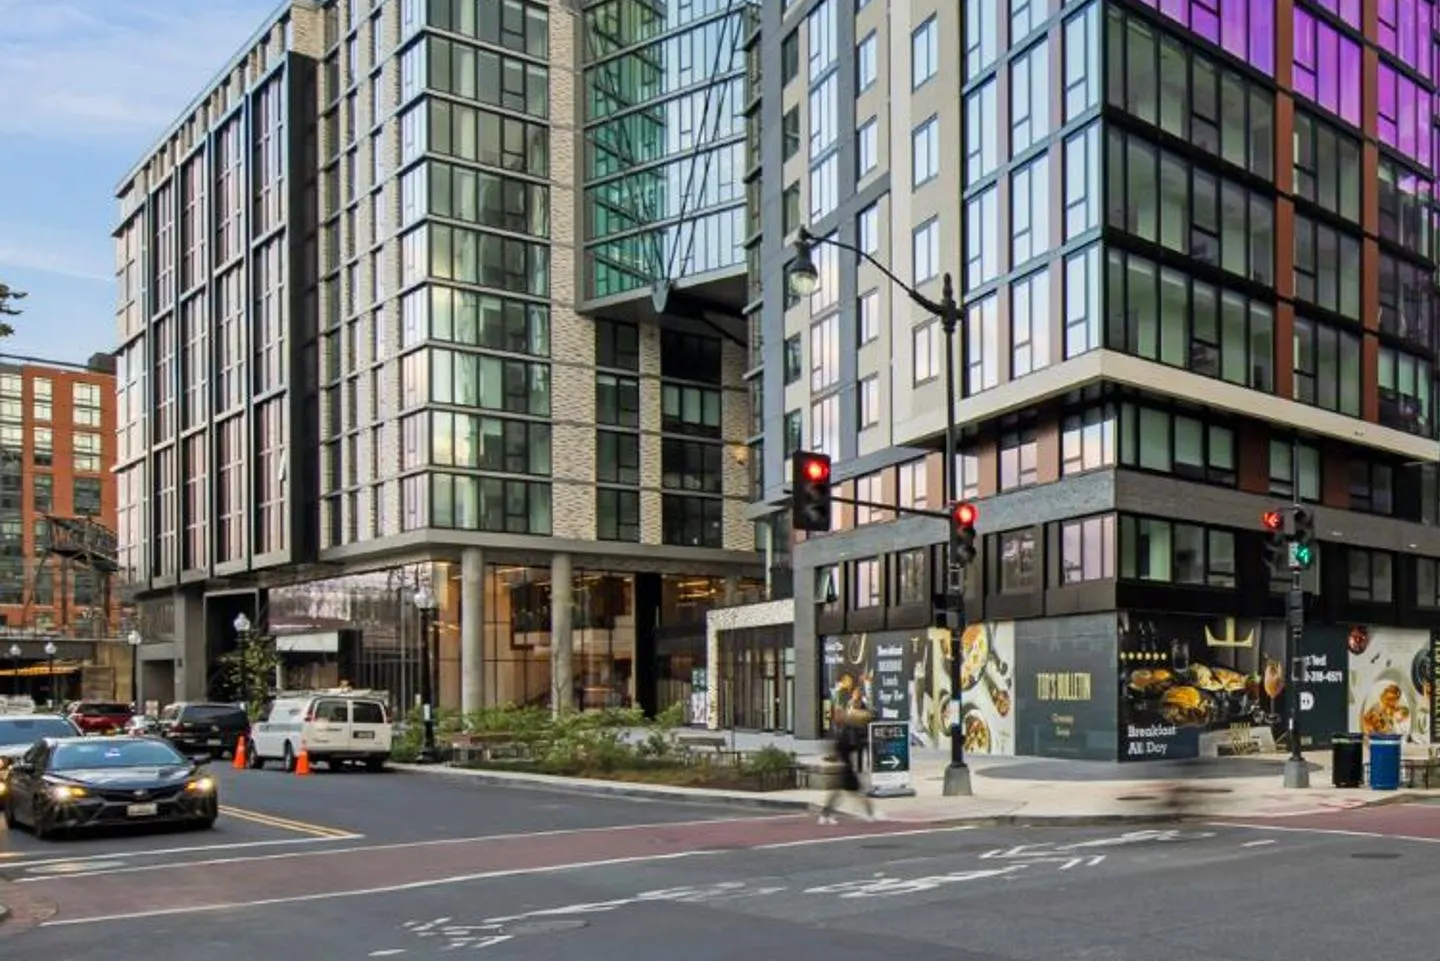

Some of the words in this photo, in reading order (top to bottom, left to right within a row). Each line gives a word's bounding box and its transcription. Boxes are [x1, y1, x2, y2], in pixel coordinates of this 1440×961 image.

[1037, 672, 1056, 700] TED'S
[1057, 672, 1091, 700] BULLETIN
[1127, 722, 1176, 739] Breakfast
[1127, 741, 1144, 755] All
[1145, 741, 1168, 756] Day
